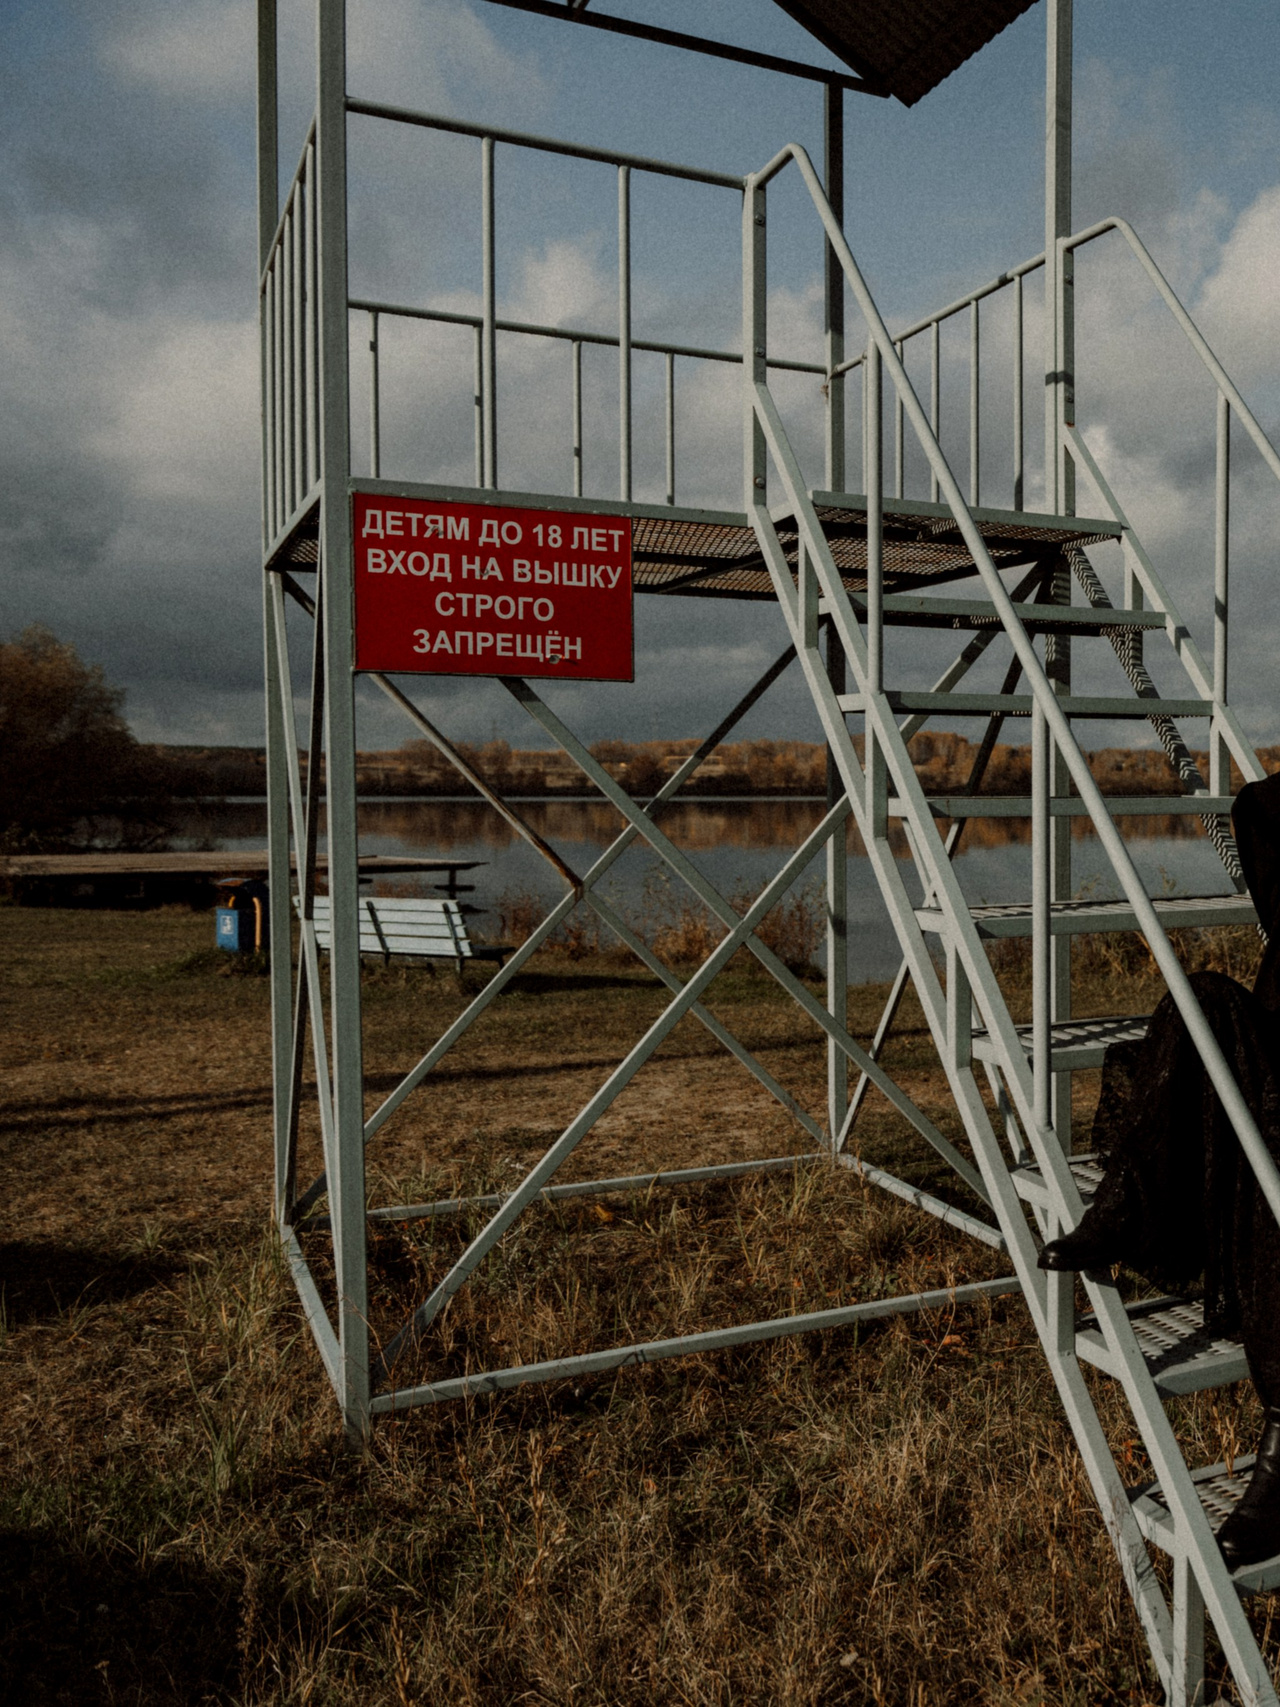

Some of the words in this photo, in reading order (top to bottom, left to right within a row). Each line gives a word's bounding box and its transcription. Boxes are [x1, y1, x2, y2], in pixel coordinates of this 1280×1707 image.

[361, 509, 470, 541] ДЕТЯМ
[478, 519, 523, 548] ДО
[532, 524, 563, 548] 18
[570, 526, 625, 553] ЛЕТ
[366, 548, 452, 582] ВХОД
[461, 555, 504, 582] НА
[513, 559, 623, 589] ВЫШКУ
[434, 591, 555, 622] СТРОГО
[412, 628, 583, 662] ЗАПРЕЩЁН
